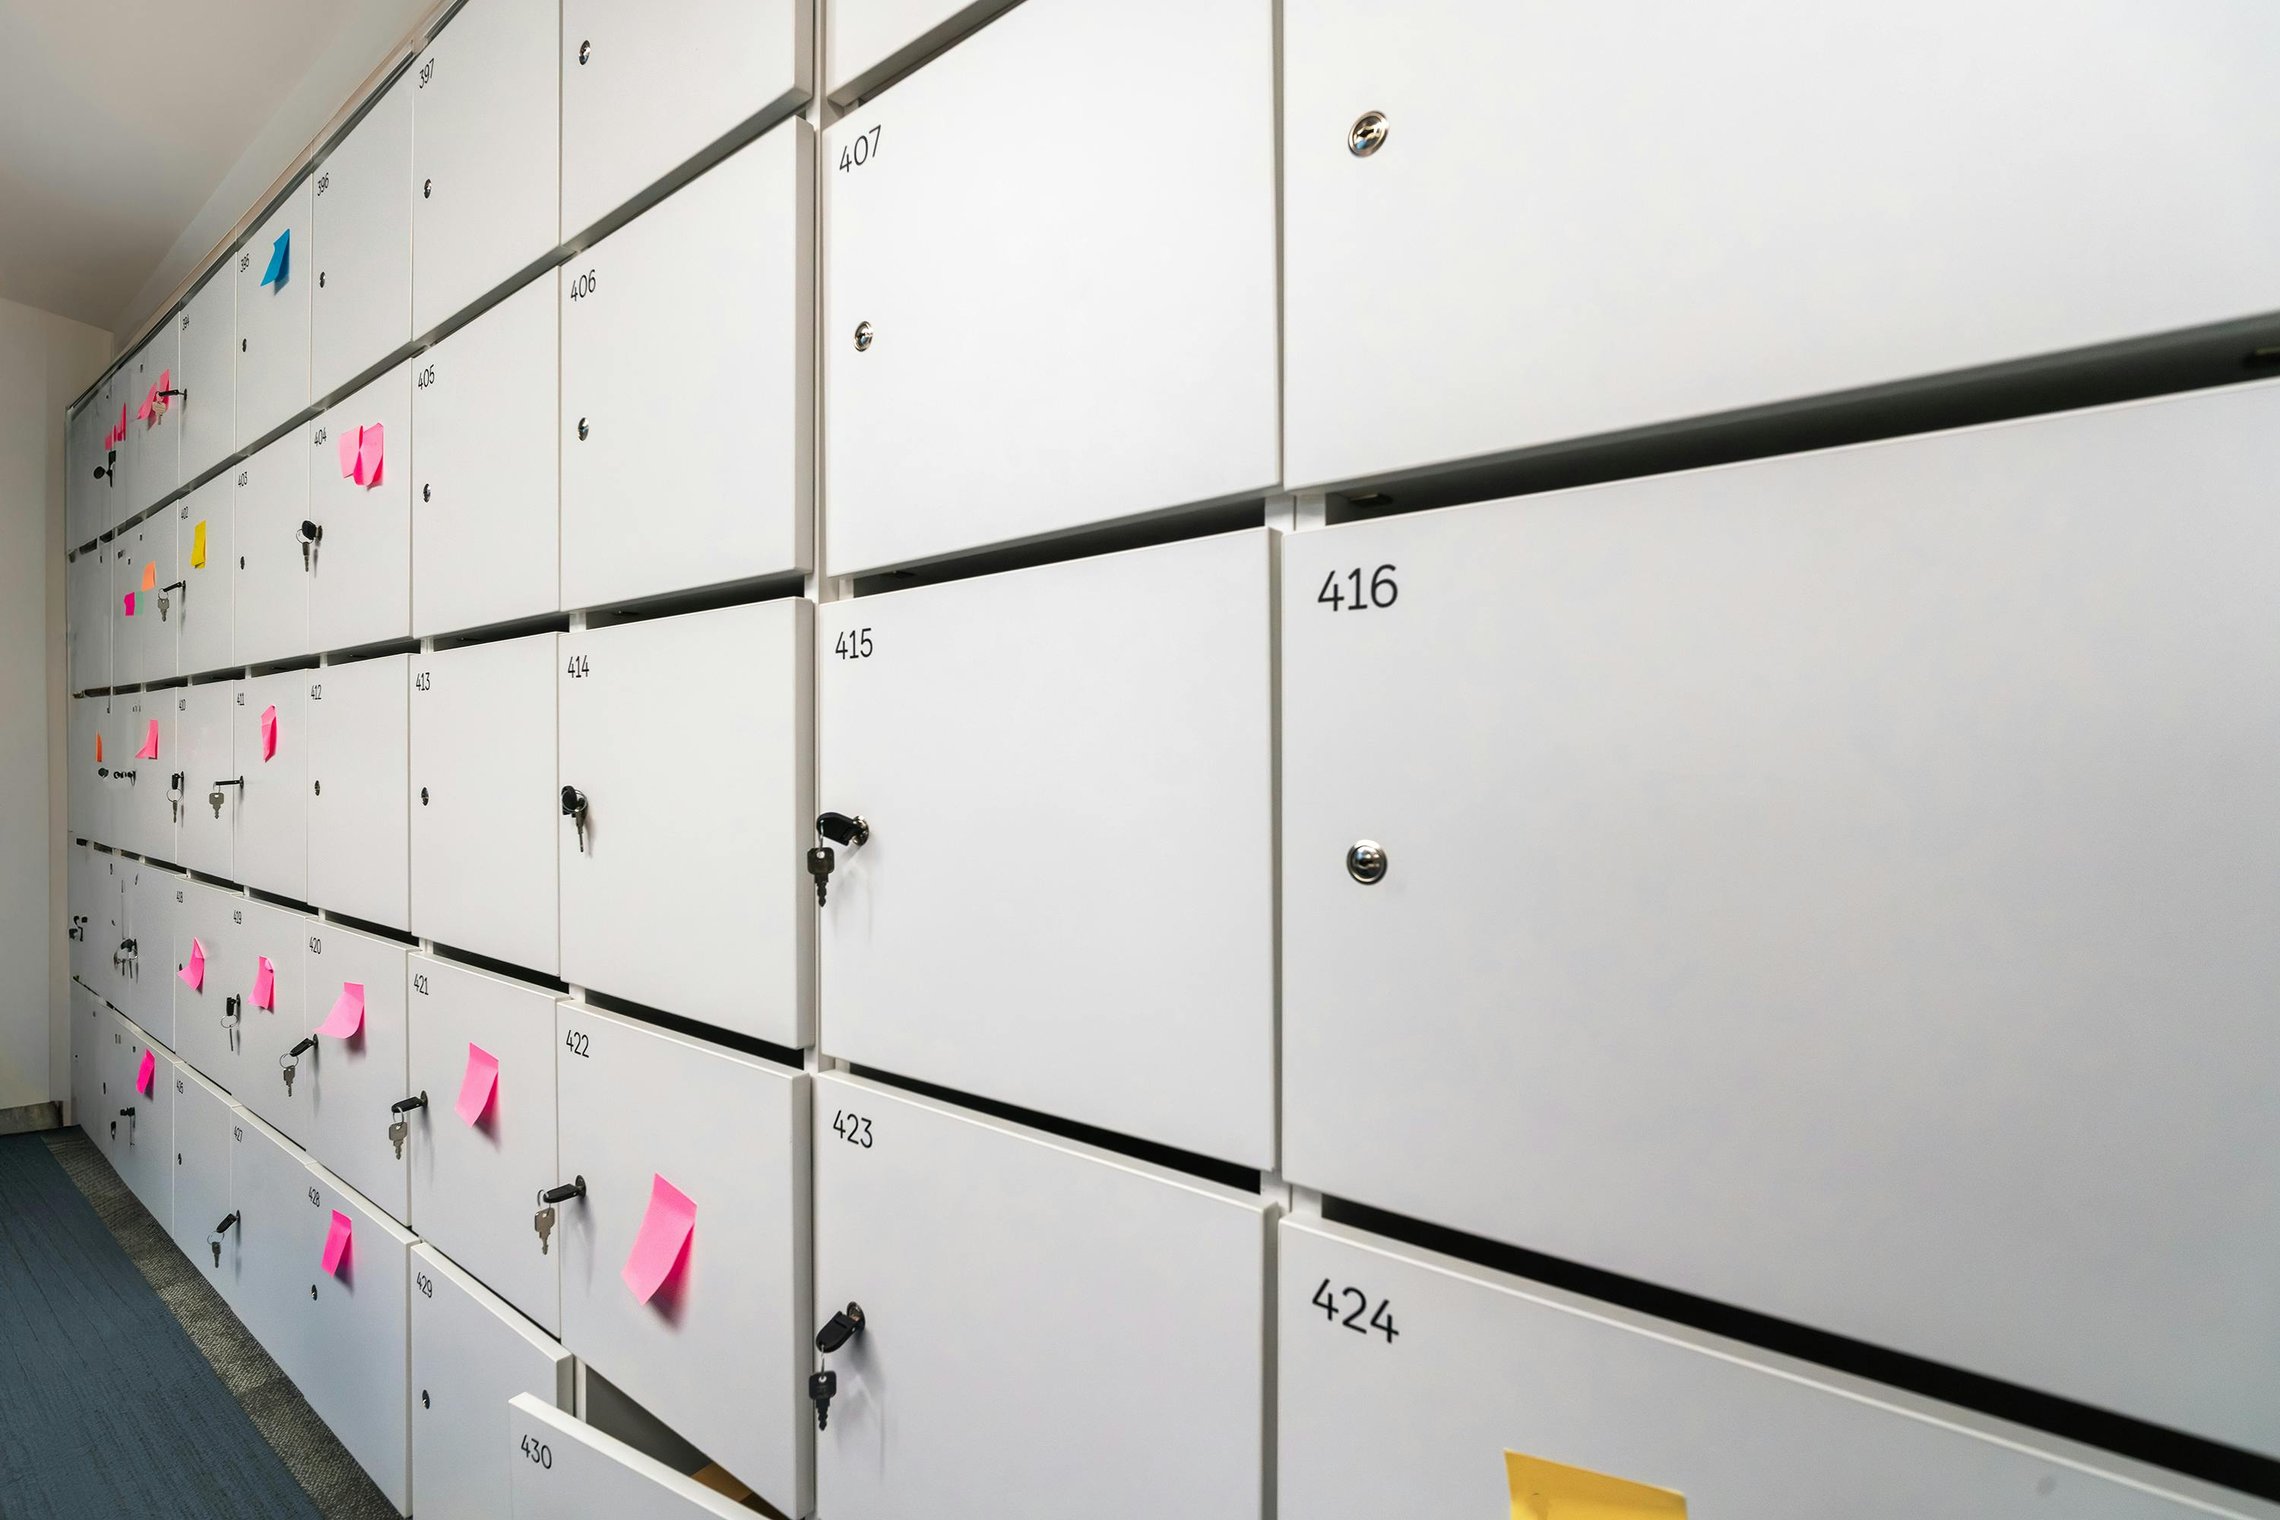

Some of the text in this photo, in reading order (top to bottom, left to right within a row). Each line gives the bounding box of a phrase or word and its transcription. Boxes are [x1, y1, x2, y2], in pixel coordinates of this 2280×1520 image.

[419, 57, 435, 89] 397
[839, 124, 882, 173] 407
[317, 172, 330, 197] 396
[570, 268, 596, 302] 406
[417, 364, 435, 390] 405
[314, 427, 327, 446] 404
[1318, 564, 1398, 611] 416
[836, 628, 872, 659] 415
[568, 655, 589, 678] 414
[310, 684, 322, 701] 412
[415, 671, 431, 692] 413
[309, 936, 322, 955] 420
[413, 973, 429, 996] 421
[566, 1030, 589, 1058] 422
[233, 1126, 243, 1144] 427
[833, 1110, 872, 1148] 423
[308, 1186, 321, 1208] 428
[416, 1271, 433, 1299] 429
[1312, 1279, 1399, 1343] 424
[521, 1435, 552, 1469] 430
